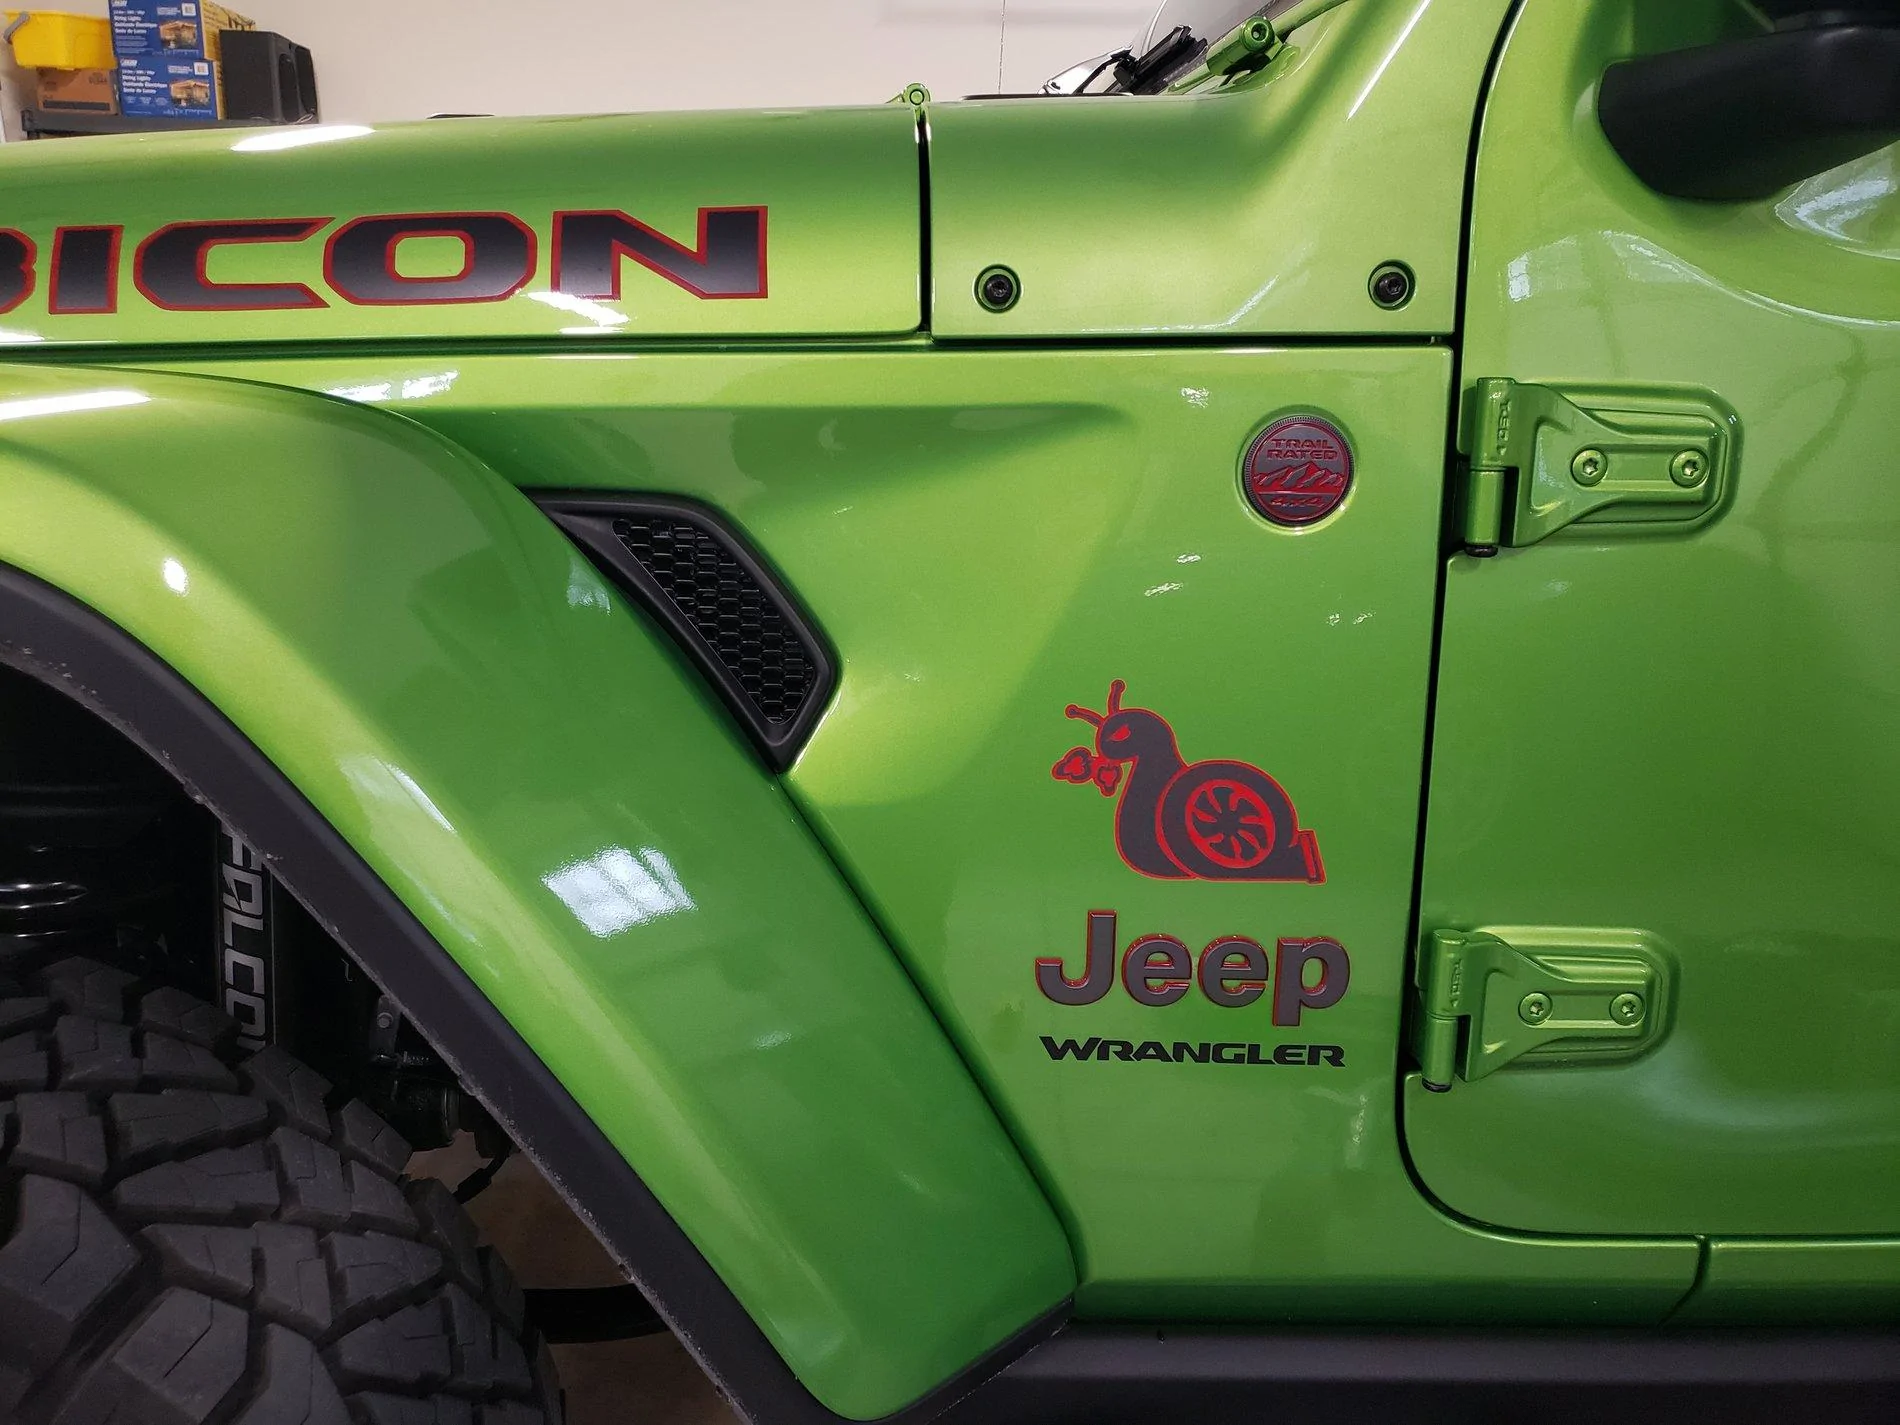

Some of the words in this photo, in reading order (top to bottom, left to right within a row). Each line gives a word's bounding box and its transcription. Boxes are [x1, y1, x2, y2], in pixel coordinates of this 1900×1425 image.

[1266, 449, 1338, 460] RATED
[1271, 438, 1335, 450] TRAIL
[1035, 909, 1351, 1027] Jeep
[1039, 1036, 1346, 1067] WRANGLER
